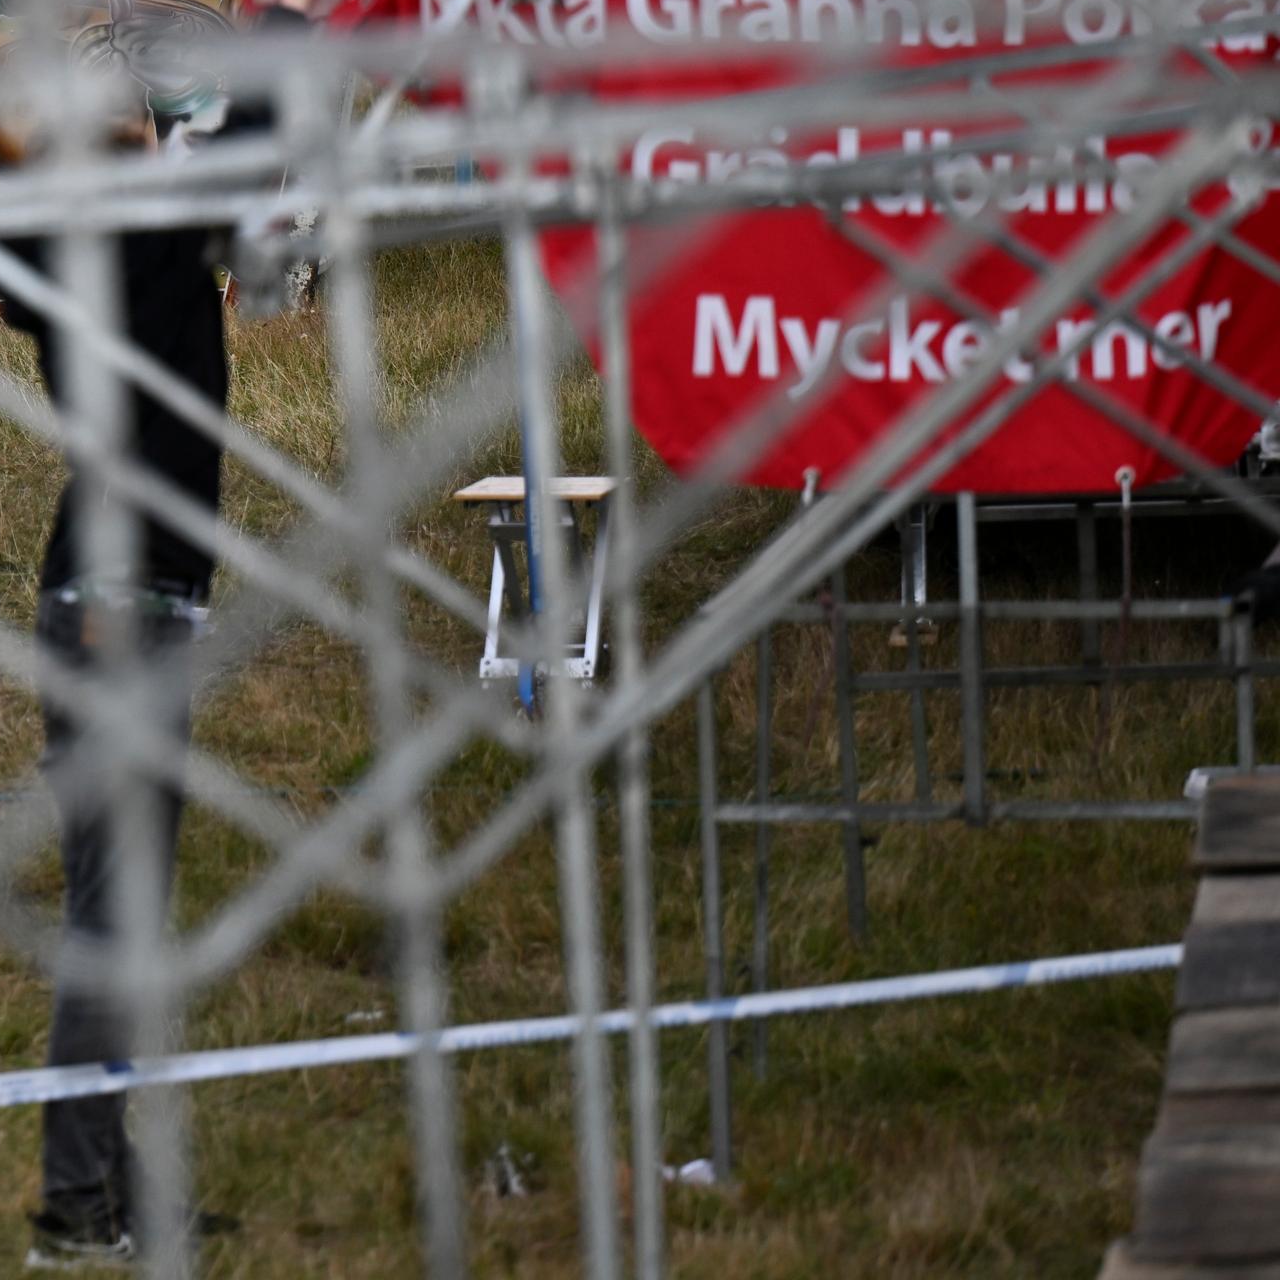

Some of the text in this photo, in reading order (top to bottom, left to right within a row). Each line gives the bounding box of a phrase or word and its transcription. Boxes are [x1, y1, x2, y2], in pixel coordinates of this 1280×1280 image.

[633, 126, 1166, 219] Gräddbulla
[692, 293, 1232, 400] Mycket mer
